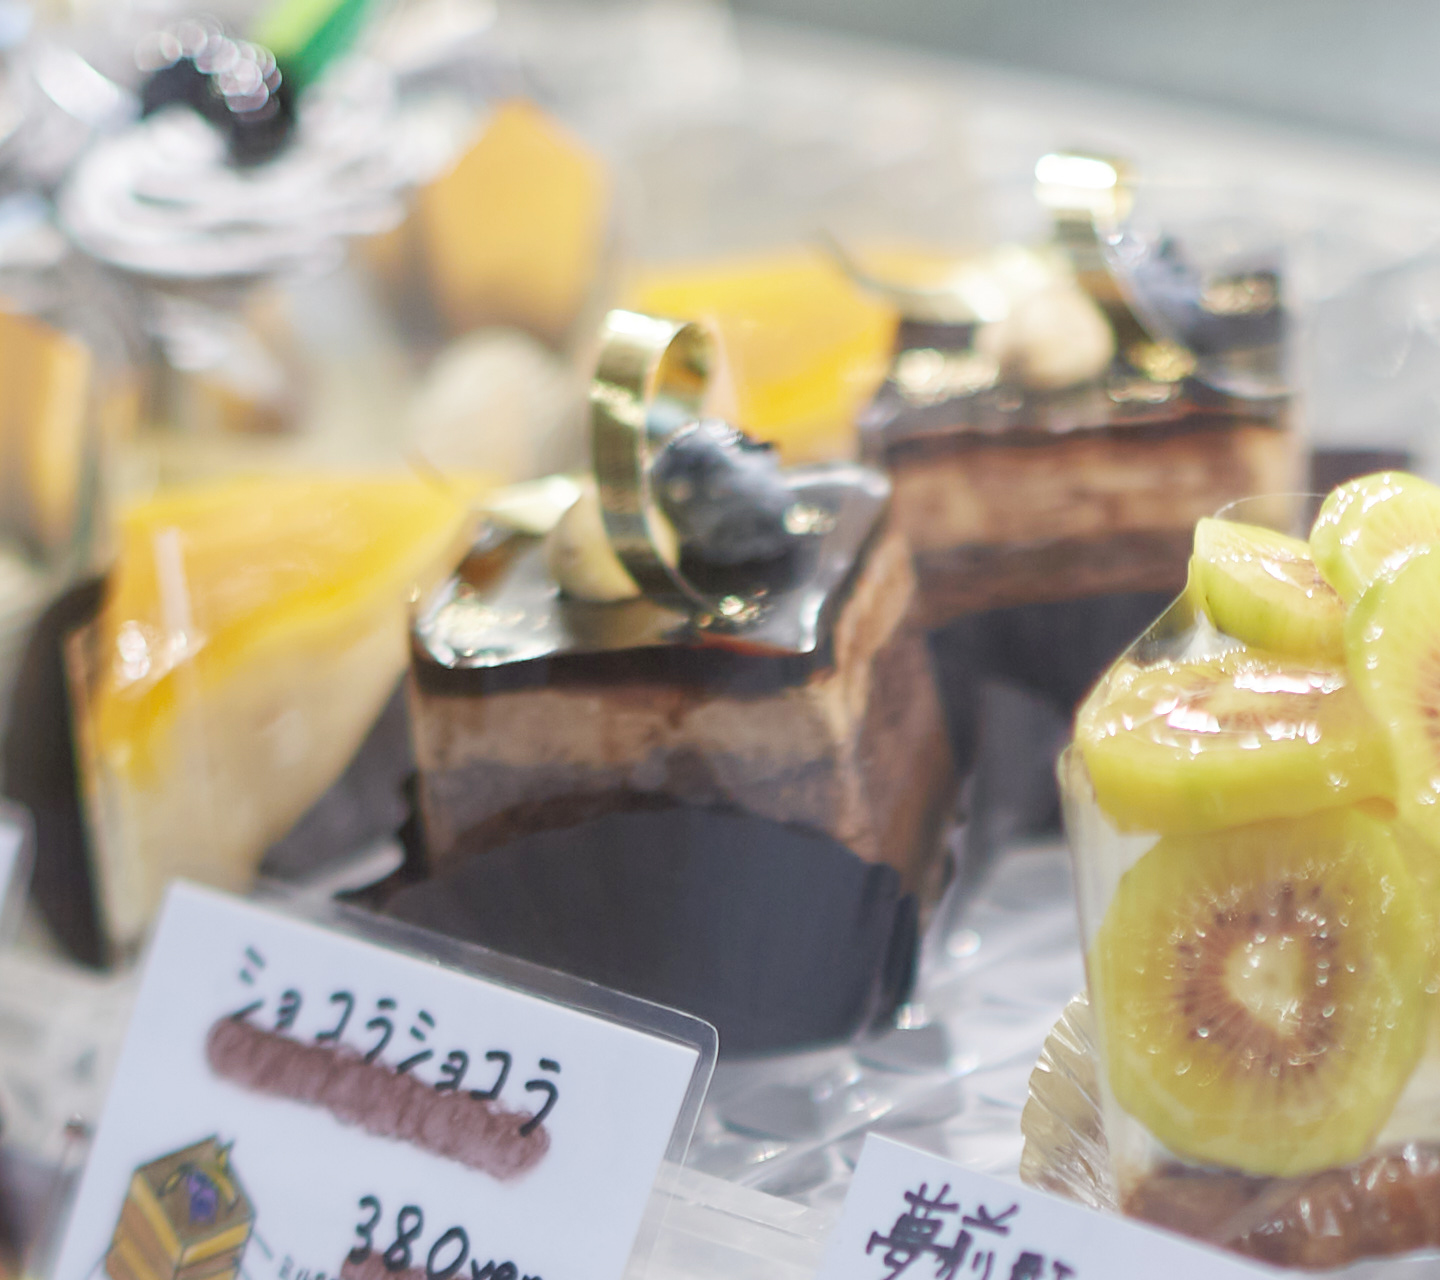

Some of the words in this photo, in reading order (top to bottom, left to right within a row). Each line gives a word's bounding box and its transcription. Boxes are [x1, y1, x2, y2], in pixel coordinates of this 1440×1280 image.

[229, 946, 561, 1137] ショコラショコラ
